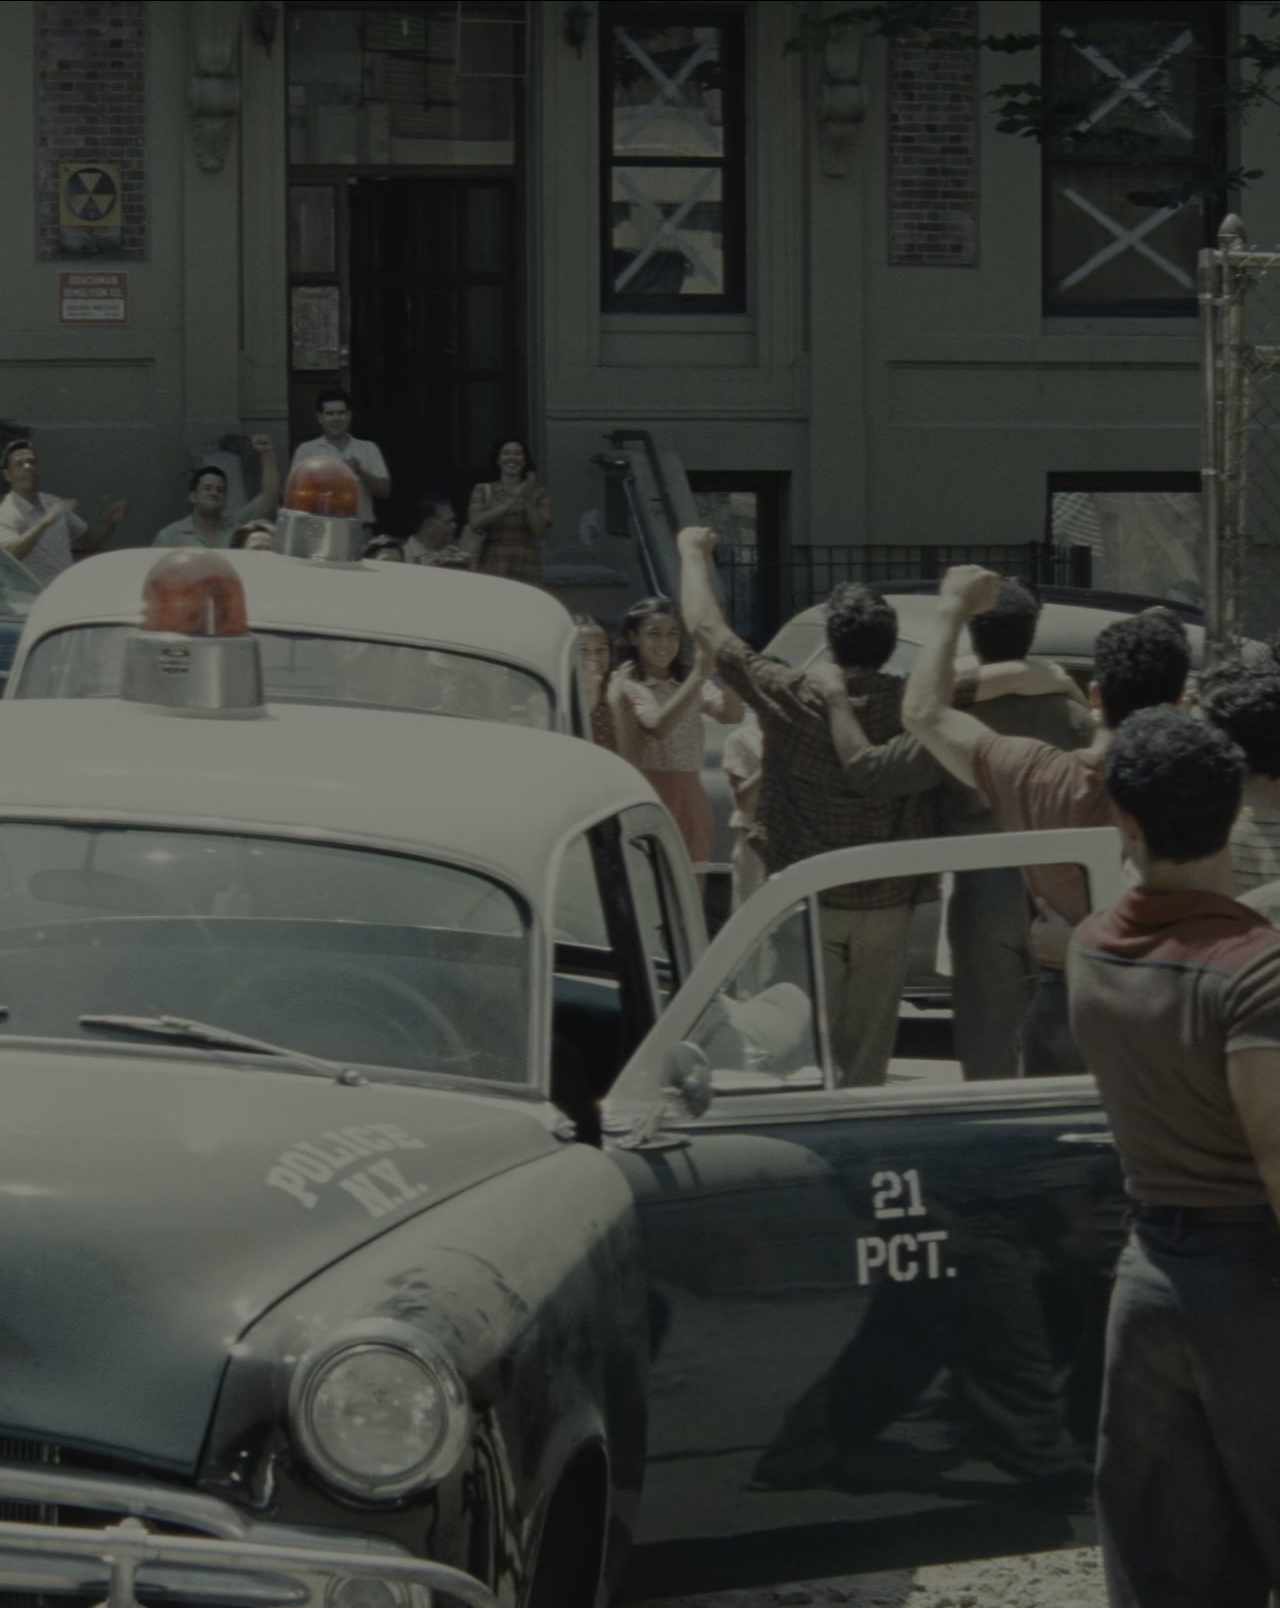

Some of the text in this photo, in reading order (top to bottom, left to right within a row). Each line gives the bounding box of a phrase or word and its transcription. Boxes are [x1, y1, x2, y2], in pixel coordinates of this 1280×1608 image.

[265, 1122, 428, 1209] POLICE
[338, 1157, 430, 1218] N.Y.
[871, 1168, 928, 1220] 21
[856, 1230, 958, 1286] PCT.
